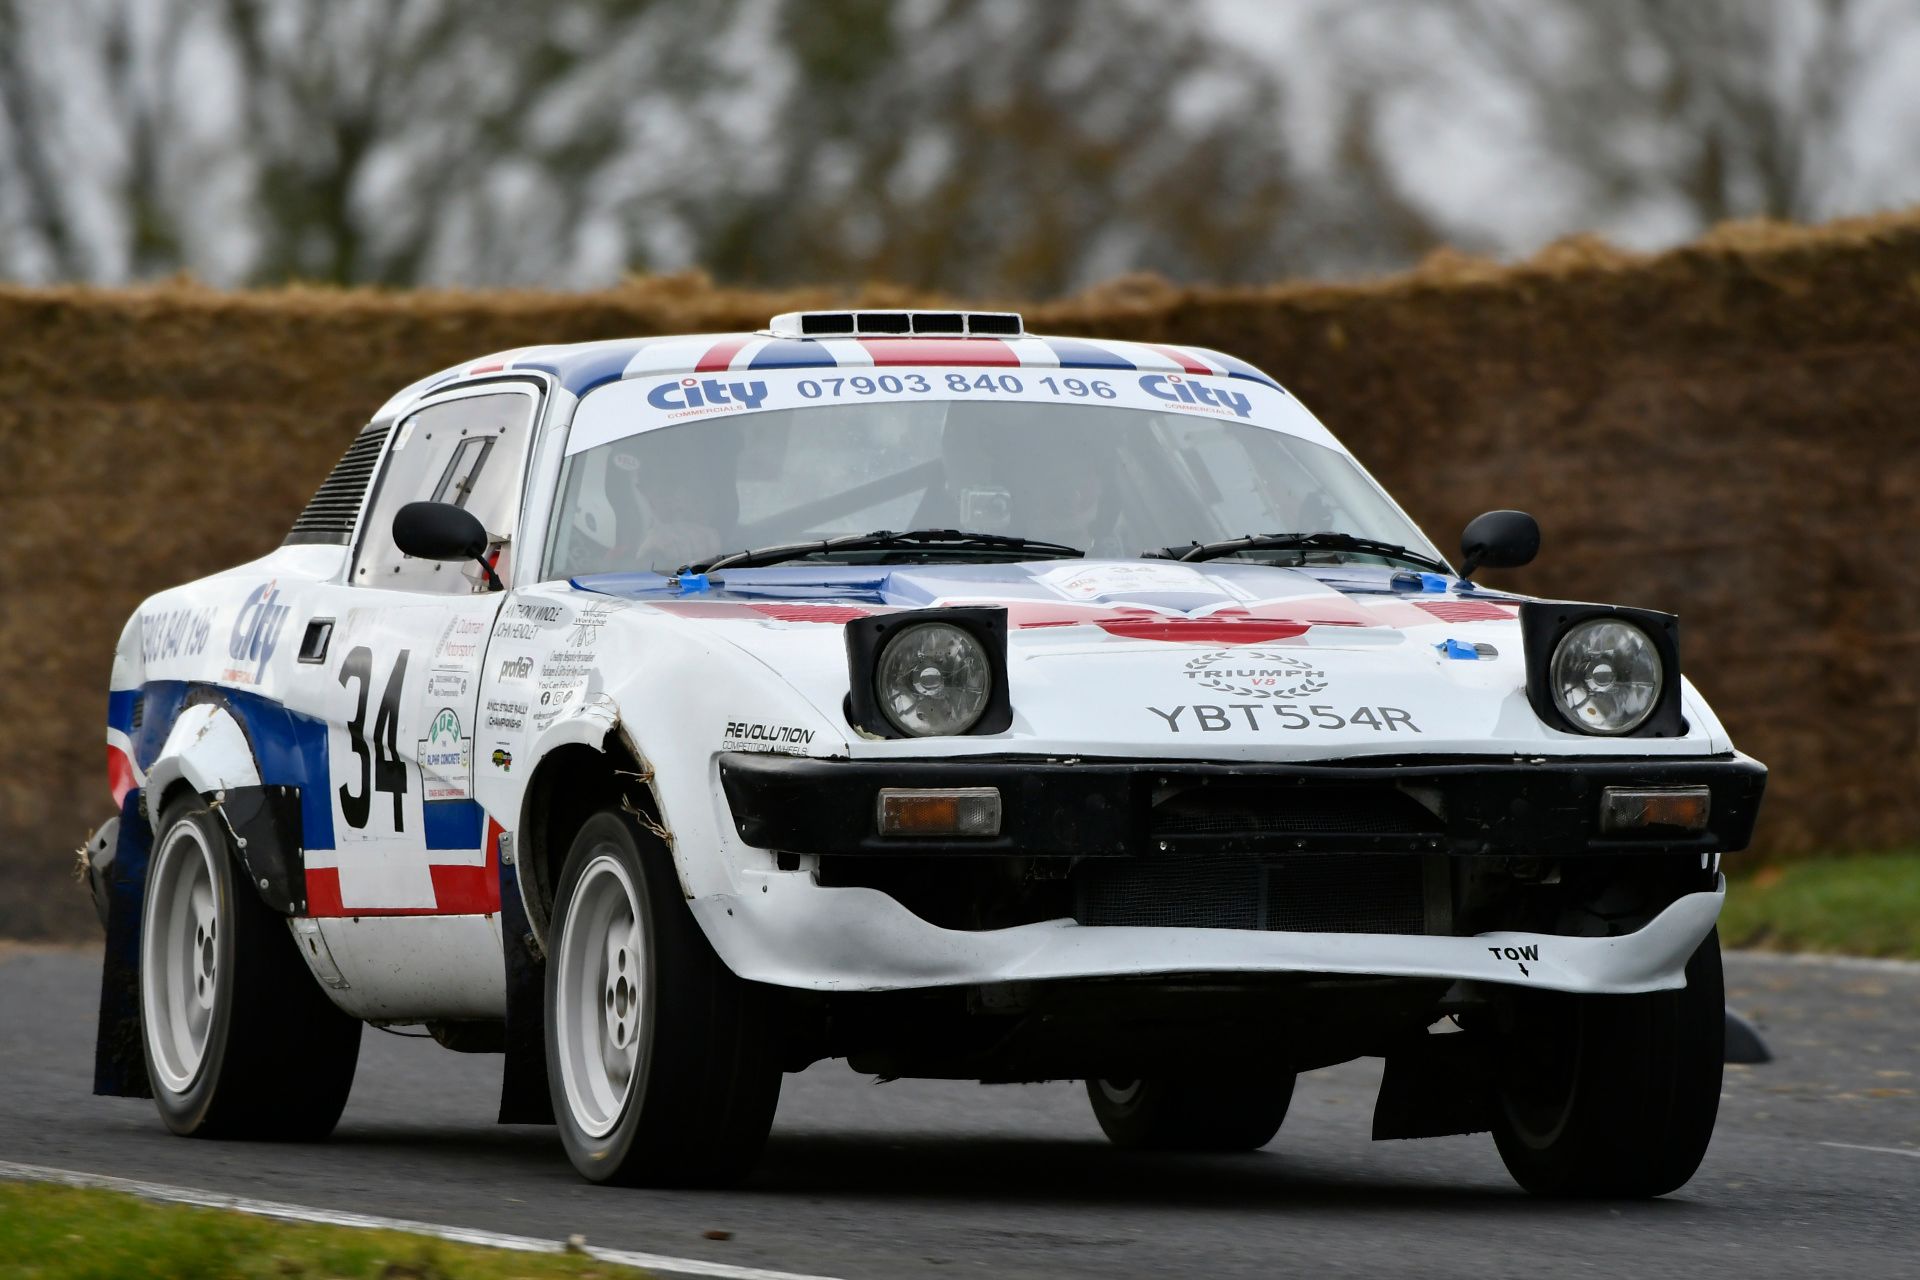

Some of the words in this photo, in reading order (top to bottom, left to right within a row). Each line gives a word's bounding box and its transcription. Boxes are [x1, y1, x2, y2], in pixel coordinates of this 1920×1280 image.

[797, 374, 931, 398] 07903
[944, 373, 1023, 394] 840
[1039, 376, 1117, 399] 196
[667, 404, 744, 419] COMMERCIALS
[1164, 403, 1234, 416] COMMERCIALS
[1183, 669, 1325, 678] TRIUMPH
[1252, 678, 1276, 686] V8
[431, 713, 459, 744] 2023
[725, 722, 815, 744] REVOLUTION
[338, 646, 410, 833] 34
[722, 740, 769, 752] COMPETITION
[777, 744, 808, 757] WHEELS
[1488, 944, 1539, 961] TOW
